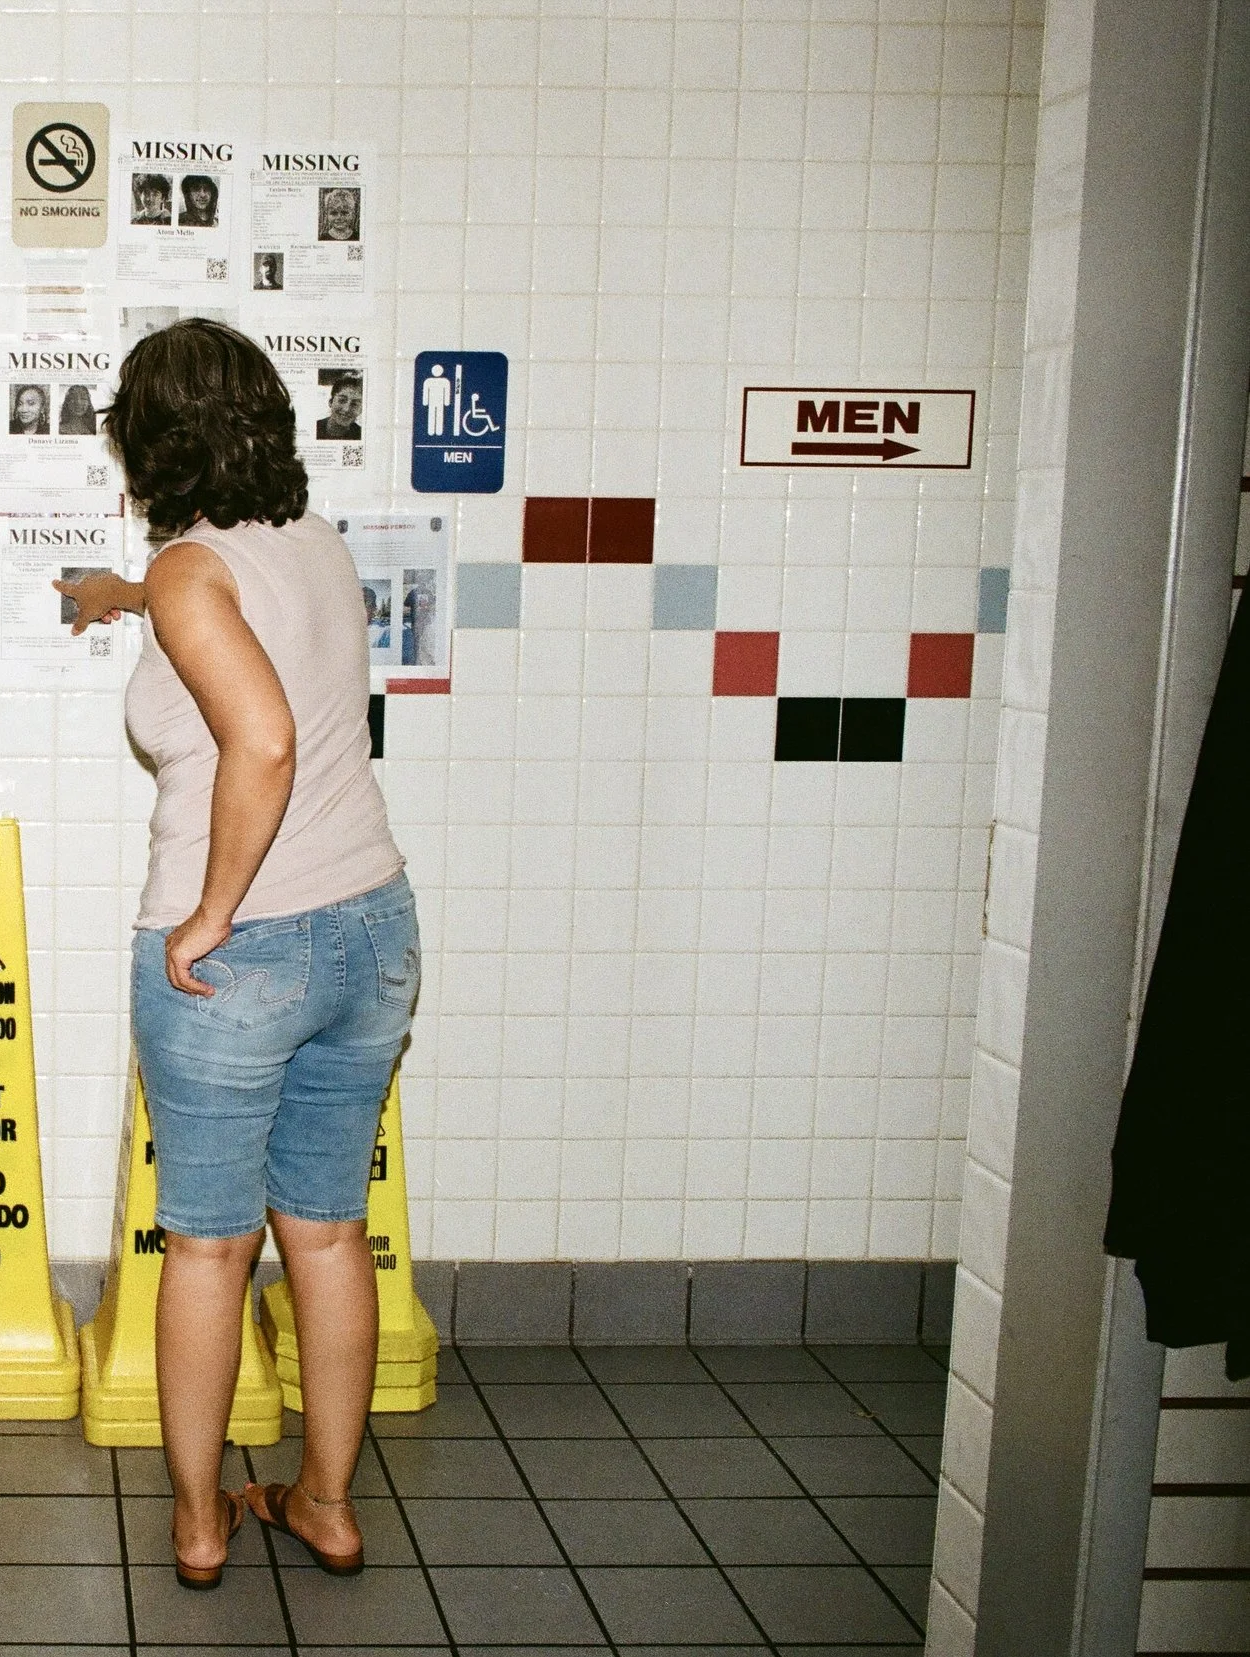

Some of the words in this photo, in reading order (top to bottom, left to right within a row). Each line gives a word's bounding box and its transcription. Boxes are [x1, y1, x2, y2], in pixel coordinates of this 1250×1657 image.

[132, 141, 233, 161] MISSING
[262, 154, 359, 171] MISSING
[20, 206, 38, 216] NO
[41, 206, 101, 217] SMOKING
[264, 335, 360, 353] MISSING
[8, 352, 110, 370] MISSING
[797, 400, 921, 434] MEN
[443, 451, 473, 463] MEN
[9, 529, 106, 545] MISSING
[369, 1236, 390, 1251] OOR
